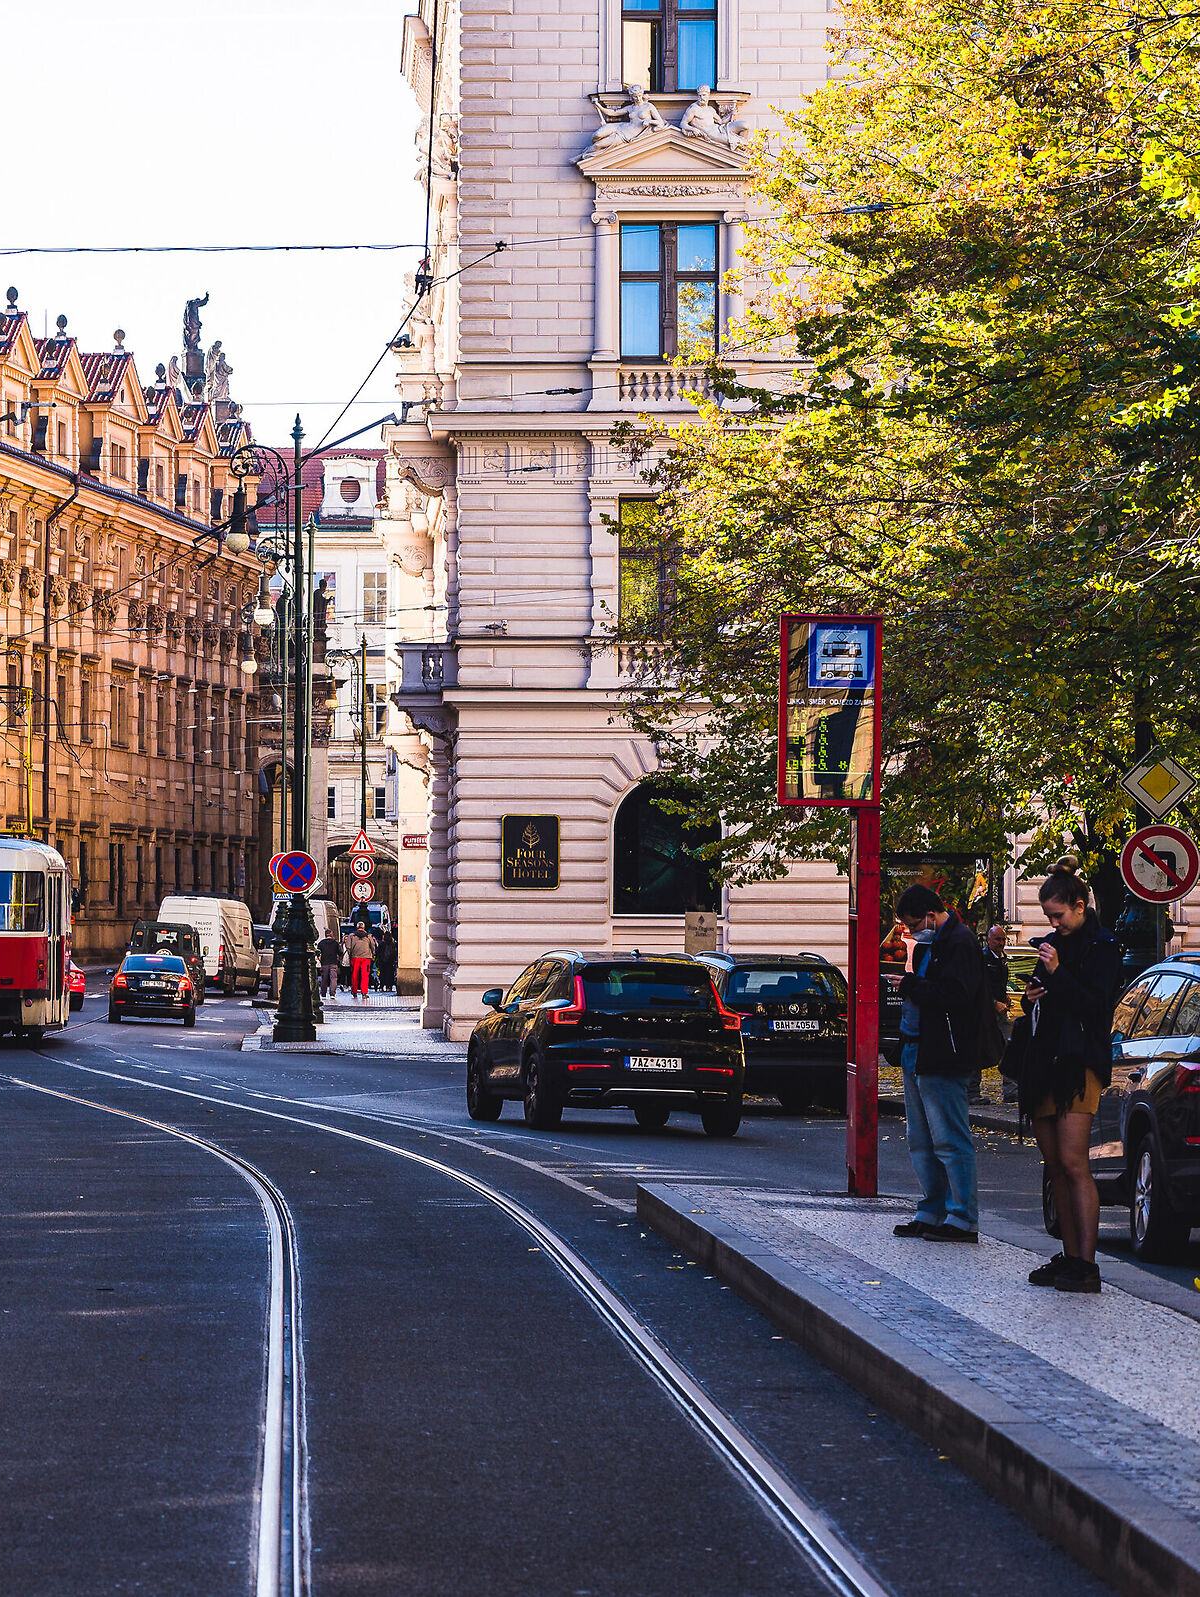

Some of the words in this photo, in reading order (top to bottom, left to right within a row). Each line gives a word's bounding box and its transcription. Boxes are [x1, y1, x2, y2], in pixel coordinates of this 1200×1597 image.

[809, 697, 826, 705] SMĚR
[516, 849, 546, 859] FOUR
[356, 861, 369, 872] 30
[506, 857, 555, 868] SEASONS
[513, 868, 551, 878] HOTEL
[775, 1021, 789, 1030] 8AH
[796, 1021, 815, 1030] 4054
[632, 1058, 649, 1067] 7AZ
[655, 1059, 678, 1069] 4313
